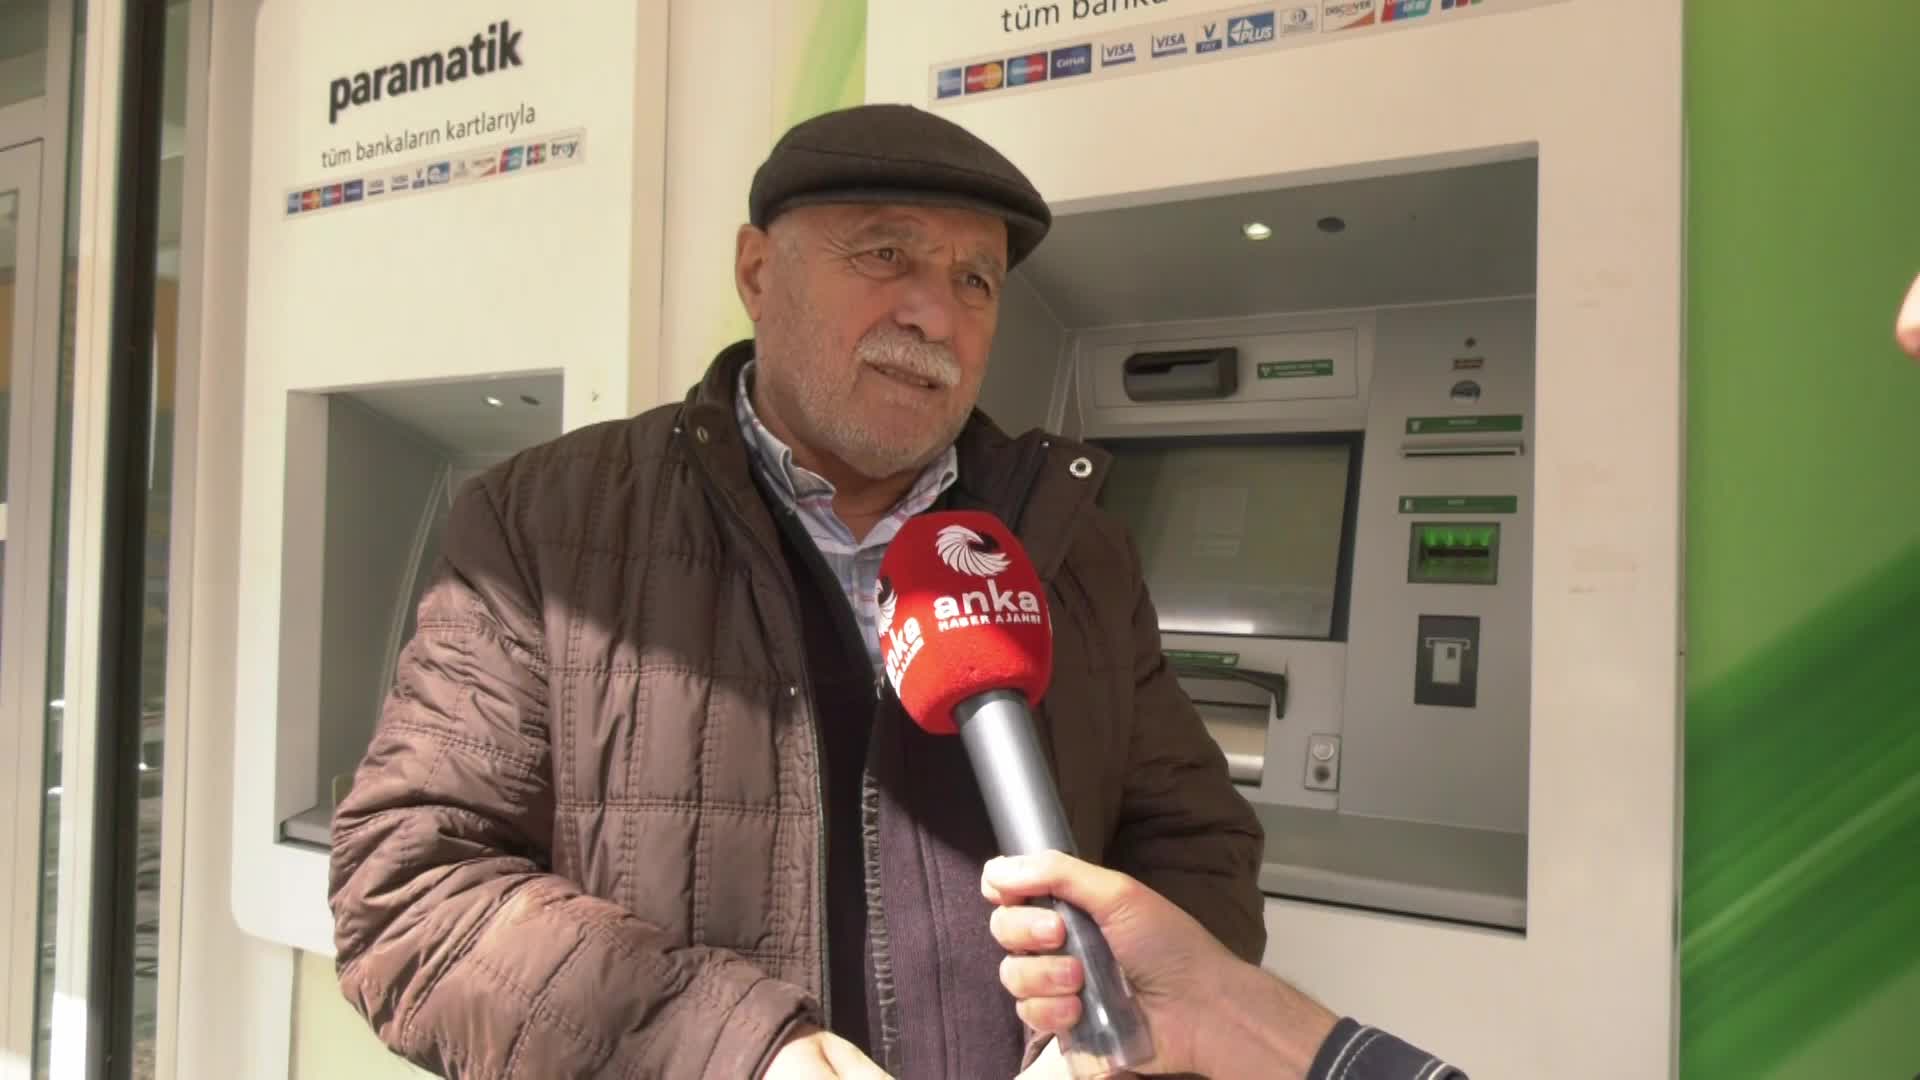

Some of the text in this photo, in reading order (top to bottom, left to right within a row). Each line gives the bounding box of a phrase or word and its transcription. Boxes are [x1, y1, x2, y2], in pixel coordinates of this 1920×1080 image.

[1000, 0, 1169, 32] tüm ban
[1156, 33, 1185, 49] VISA
[1241, 26, 1273, 42] PLUS
[1106, 42, 1134, 58] VISA
[329, 20, 523, 124] paramatik
[321, 102, 536, 168] tüm bankaların kartlarıyla
[933, 578, 1041, 620] anka
[937, 615, 991, 632] HABER
